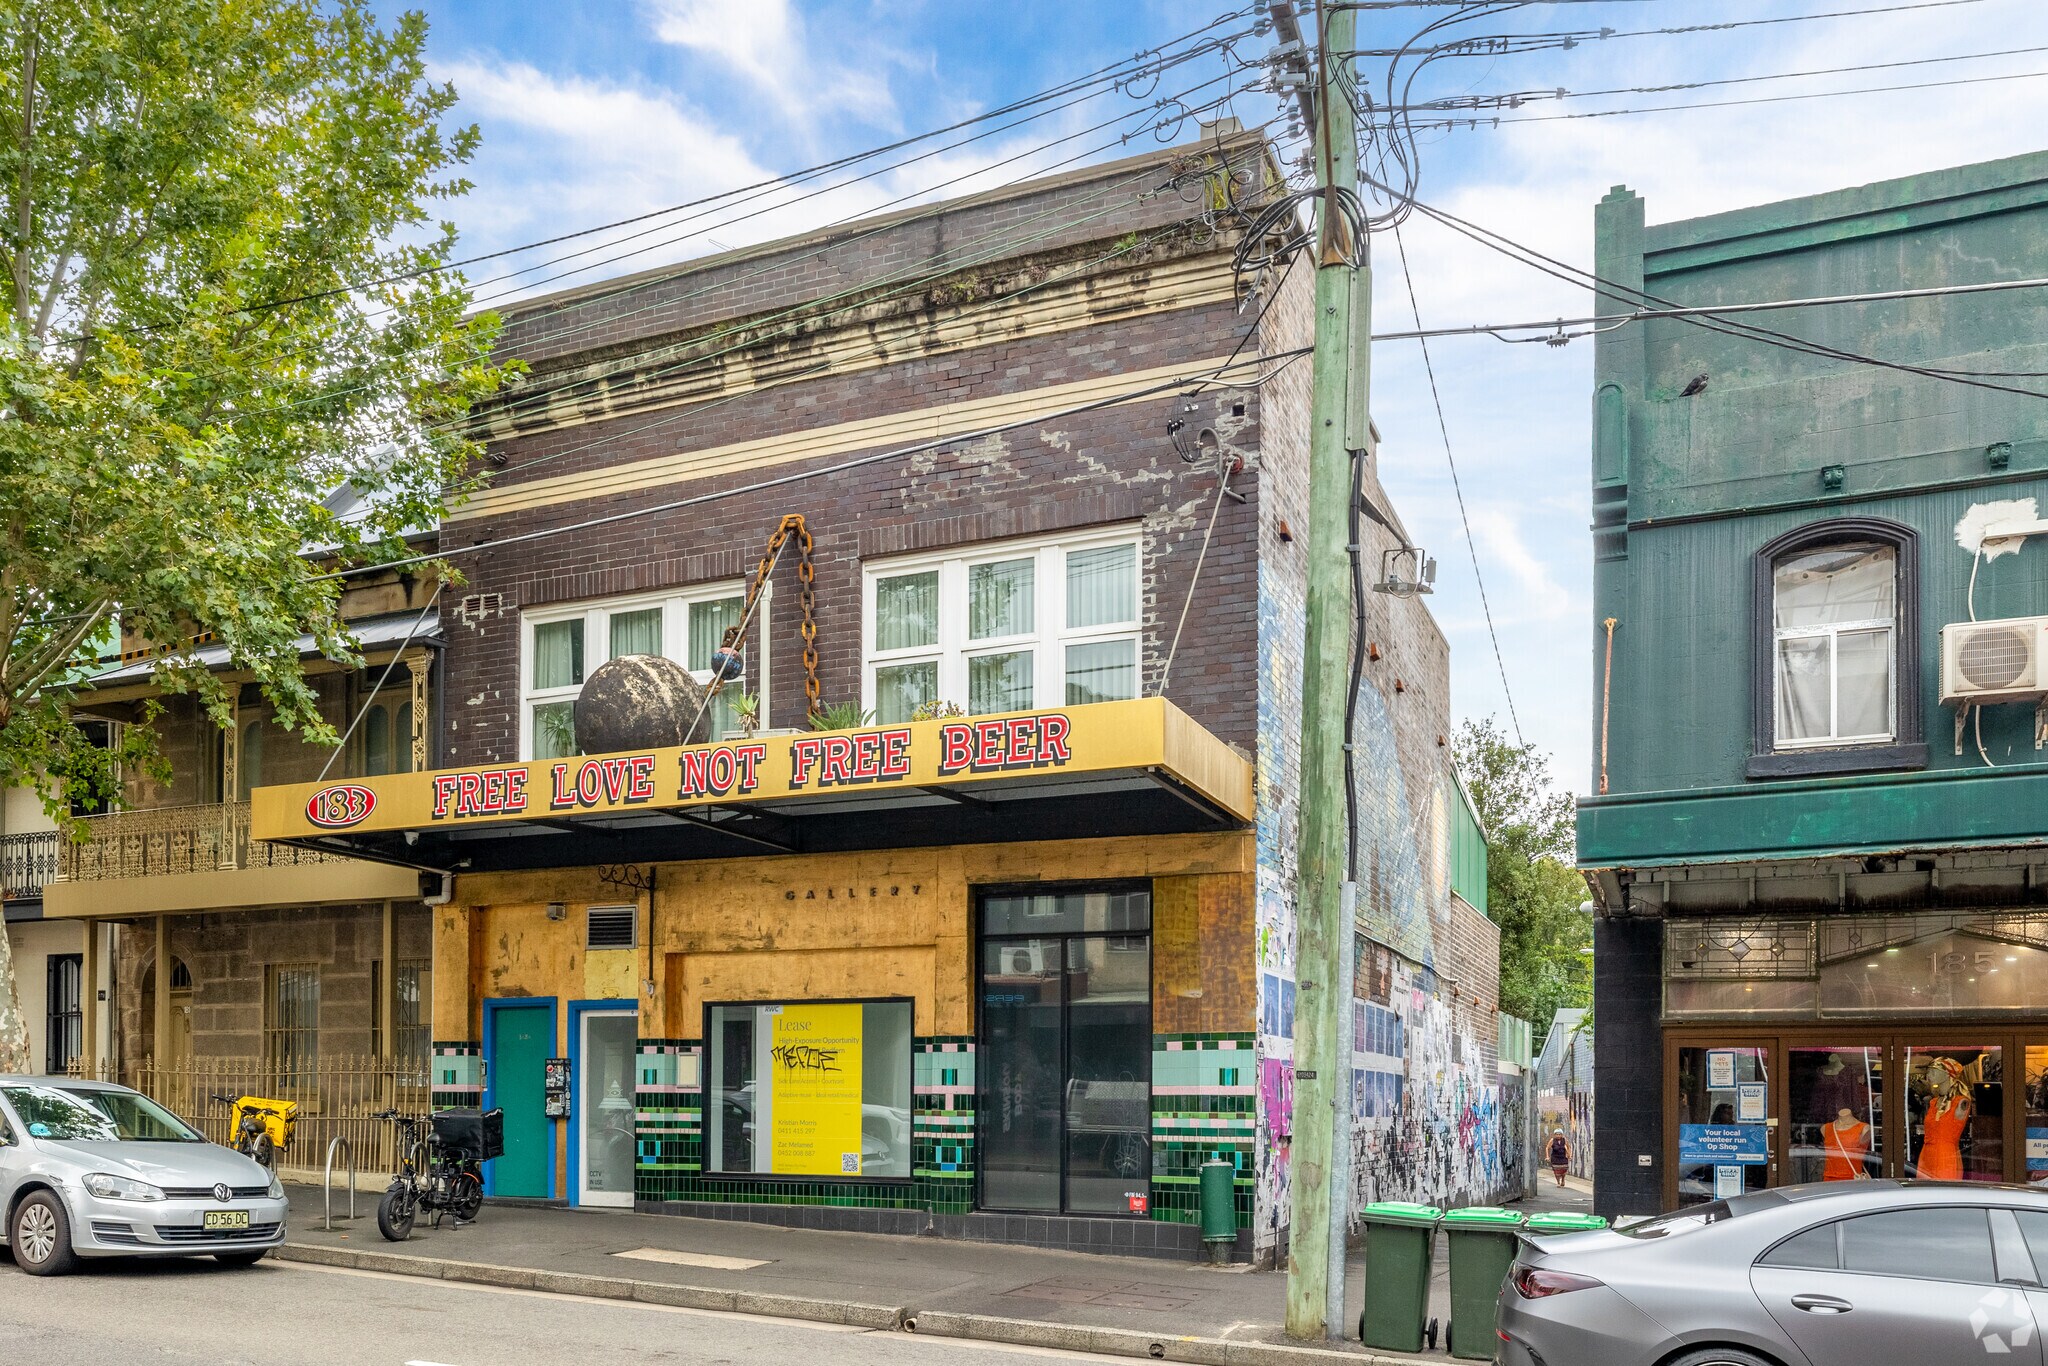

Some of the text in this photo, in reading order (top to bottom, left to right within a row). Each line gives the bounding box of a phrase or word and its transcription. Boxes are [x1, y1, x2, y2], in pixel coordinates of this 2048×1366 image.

[433, 714, 1072, 819] FREE LOVE NOT FREE BEER
[316, 792, 369, 822] 183
[785, 884, 921, 900] GALLERY
[1927, 951, 1996, 974] 185
[779, 1019, 812, 1031] Lease
[823, 1037, 860, 1045] Opportunity
[1719, 1143, 1738, 1151] Shop
[206, 1213, 247, 1225] CD 56 DC
